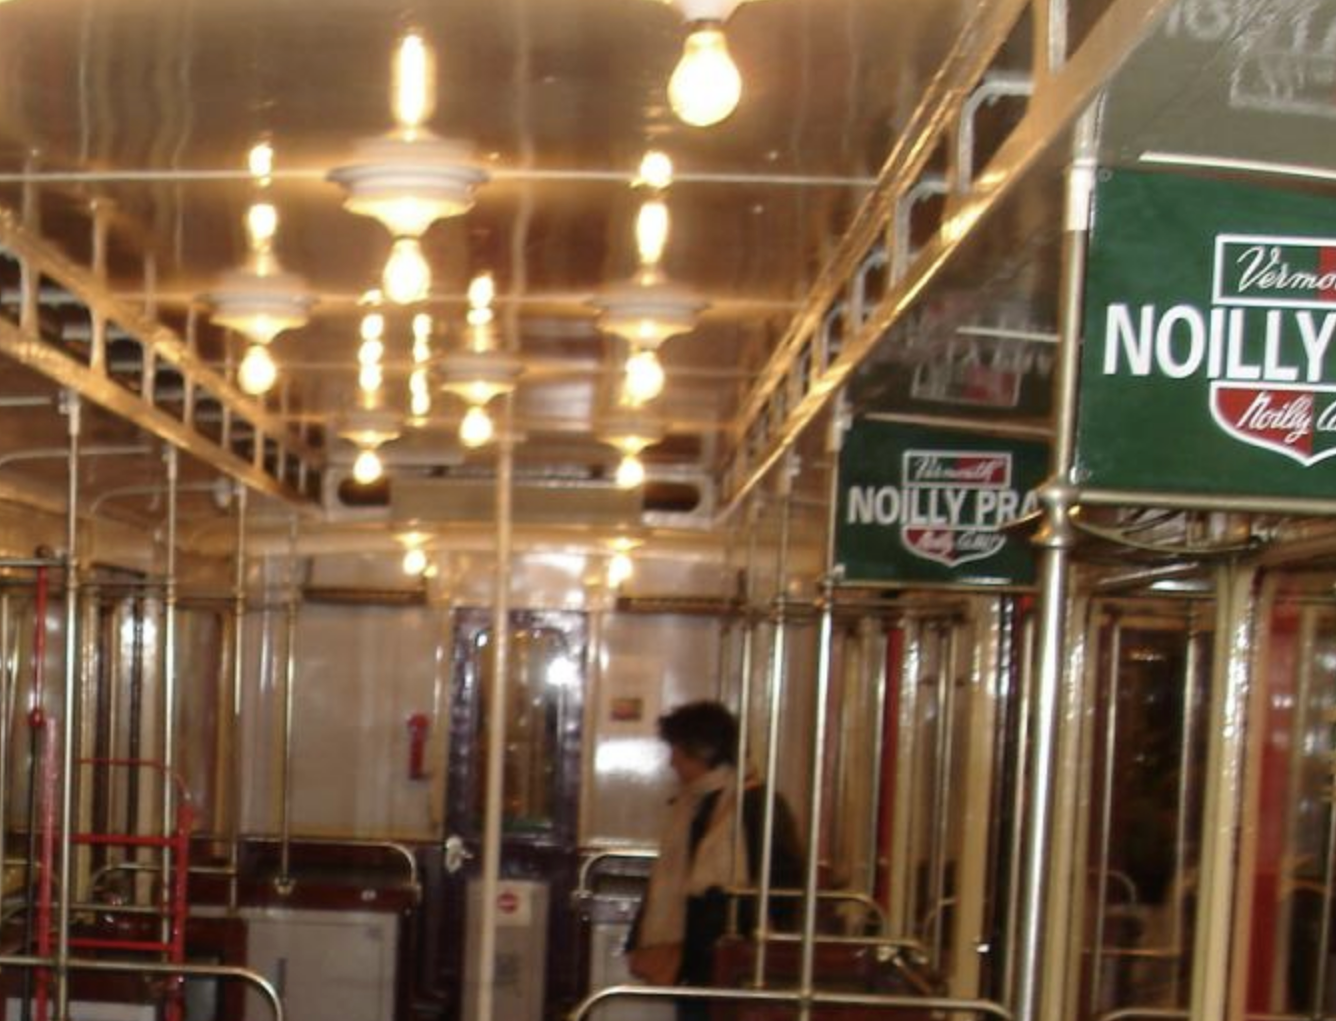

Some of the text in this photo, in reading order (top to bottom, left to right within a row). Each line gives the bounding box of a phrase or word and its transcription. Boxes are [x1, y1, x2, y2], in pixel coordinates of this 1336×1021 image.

[1103, 303, 1336, 383] NOILLY
[847, 485, 1040, 526] NOILLY PRA
